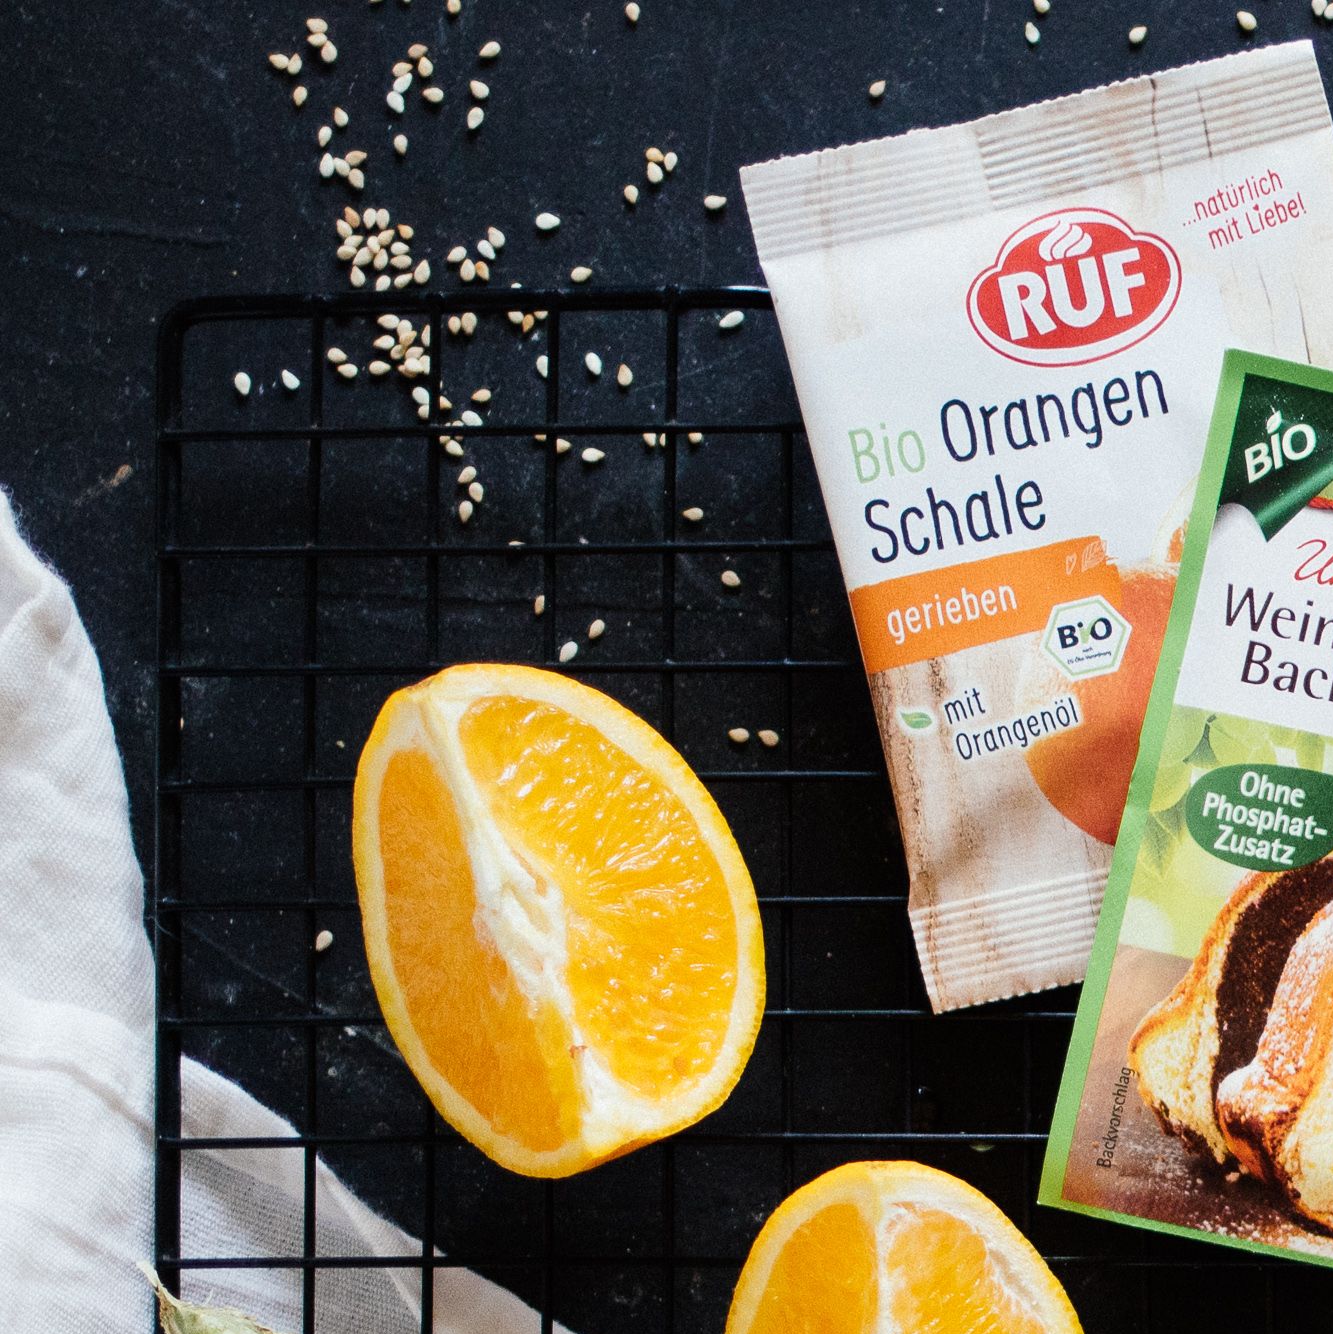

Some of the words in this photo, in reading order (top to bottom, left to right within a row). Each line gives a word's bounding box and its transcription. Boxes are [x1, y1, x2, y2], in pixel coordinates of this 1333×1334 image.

[1208, 217, 1243, 250] mit
[1245, 191, 1307, 234] Liebe!
[997, 246, 1147, 341] RUF
[847, 421, 926, 485] Bio
[940, 368, 1169, 462] Orangen
[864, 473, 1046, 563] Schale
[887, 585, 1017, 645] gerieben
[944, 688, 986, 724] mit
[955, 697, 1079, 761] Orangenöl
[1202, 791, 1328, 840] Phosphat-
[1239, 770, 1306, 808] Ohne
[1213, 824, 1296, 866] Zusatz
[1096, 1066, 1136, 1169] Backvorschlag
